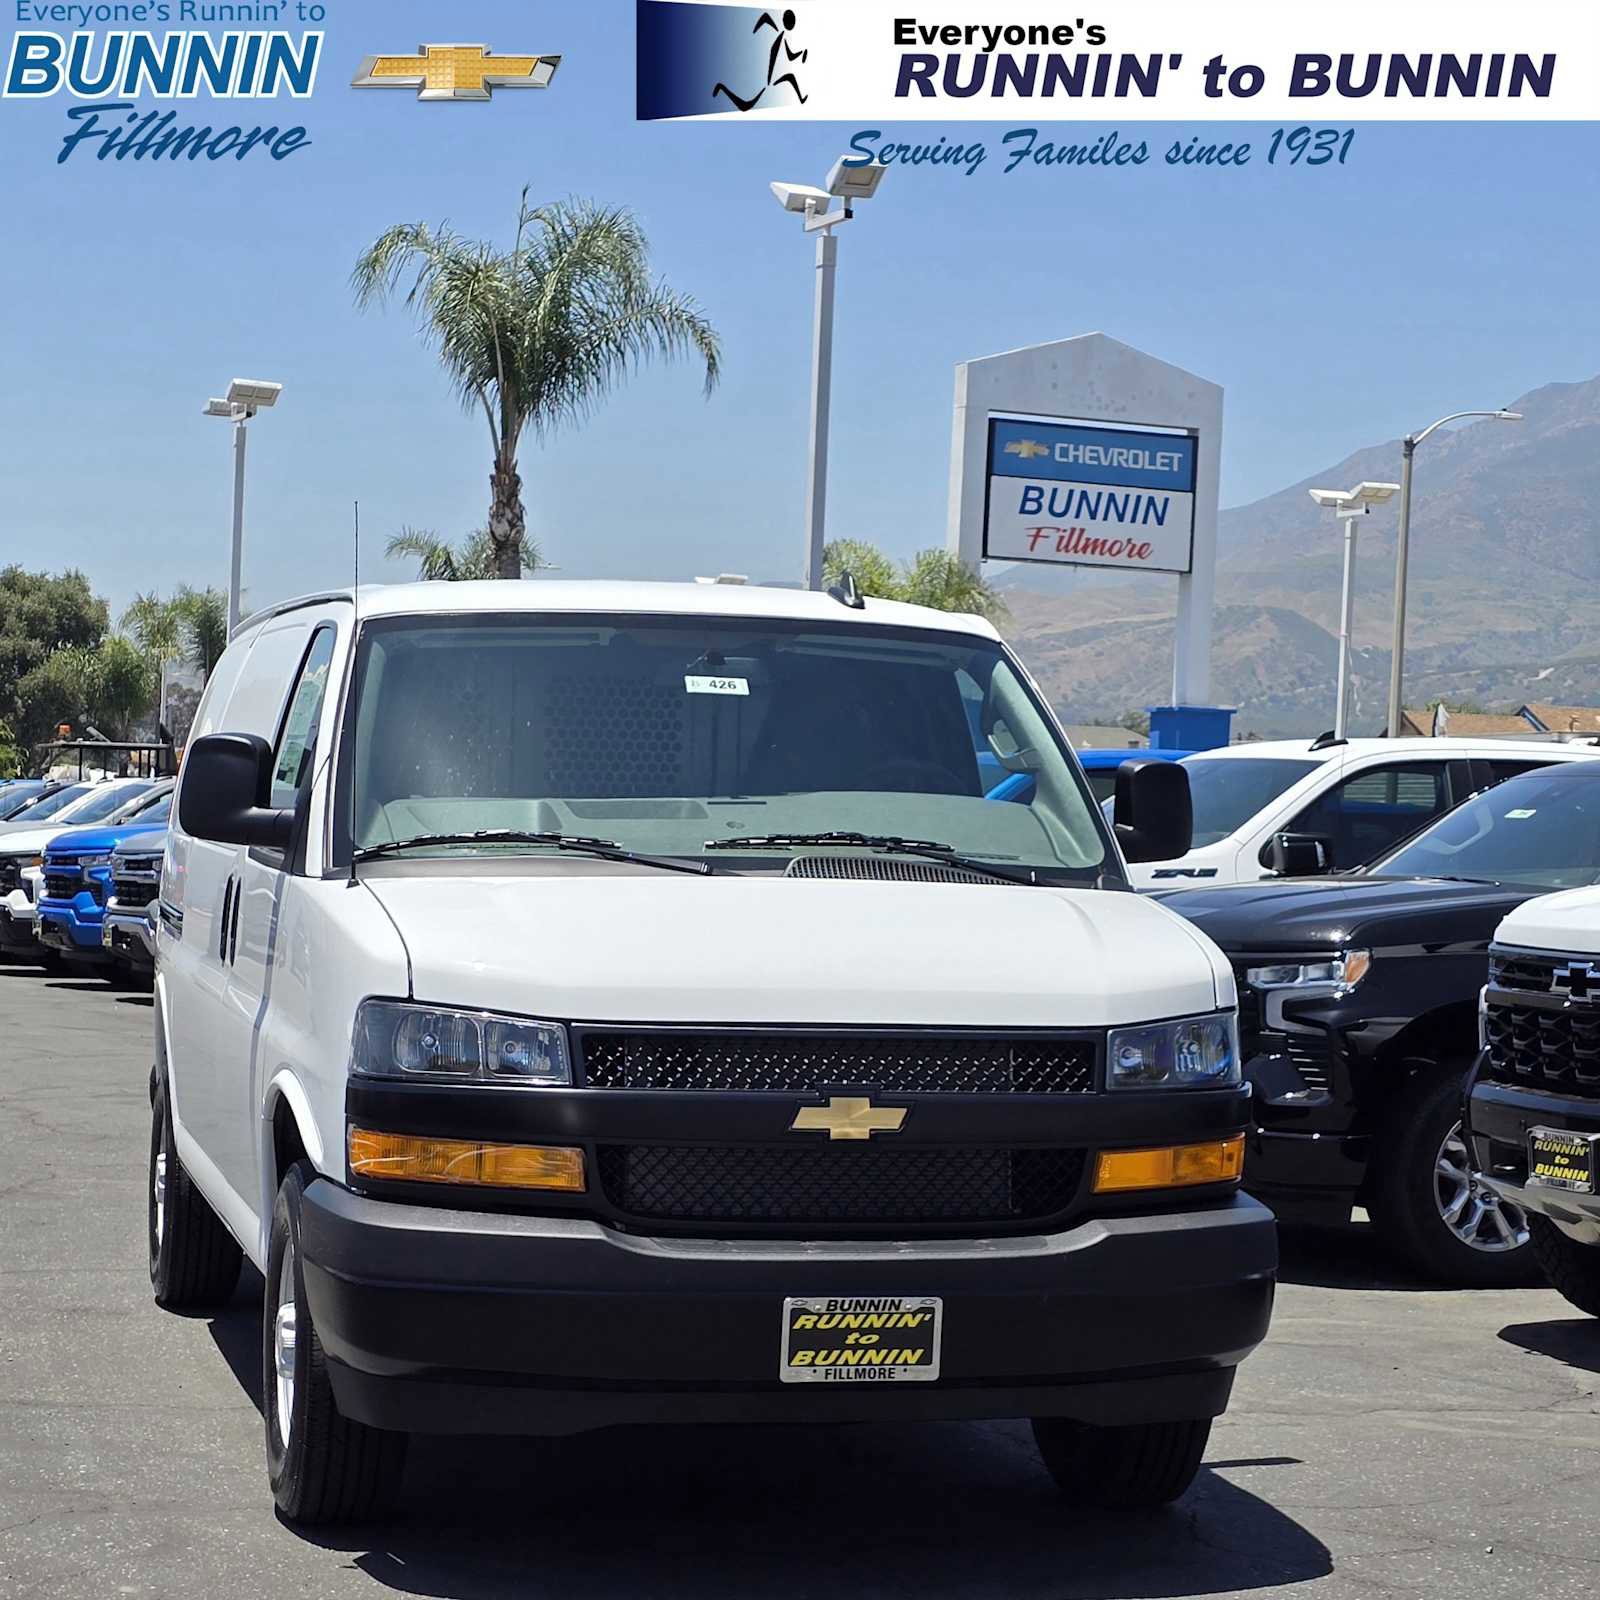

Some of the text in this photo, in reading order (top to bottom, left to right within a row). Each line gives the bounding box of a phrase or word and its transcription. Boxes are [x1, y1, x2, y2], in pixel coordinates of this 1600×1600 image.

[1054, 442, 1183, 472] CHEVROLET
[1018, 485, 1170, 526] BUNNIN
[1025, 526, 1154, 560] Fillmore
[709, 679, 737, 689] 426
[1534, 1140, 1590, 1156] RUNNIN'
[1554, 1155, 1570, 1165] to
[1535, 1163, 1589, 1181] BUNNIN
[826, 1299, 903, 1312] BUNNIN
[792, 1313, 932, 1330] RUNNIN'
[844, 1332, 880, 1344] to
[789, 1348, 925, 1366] BUNNIN
[824, 1367, 896, 1380] FILLMORE
